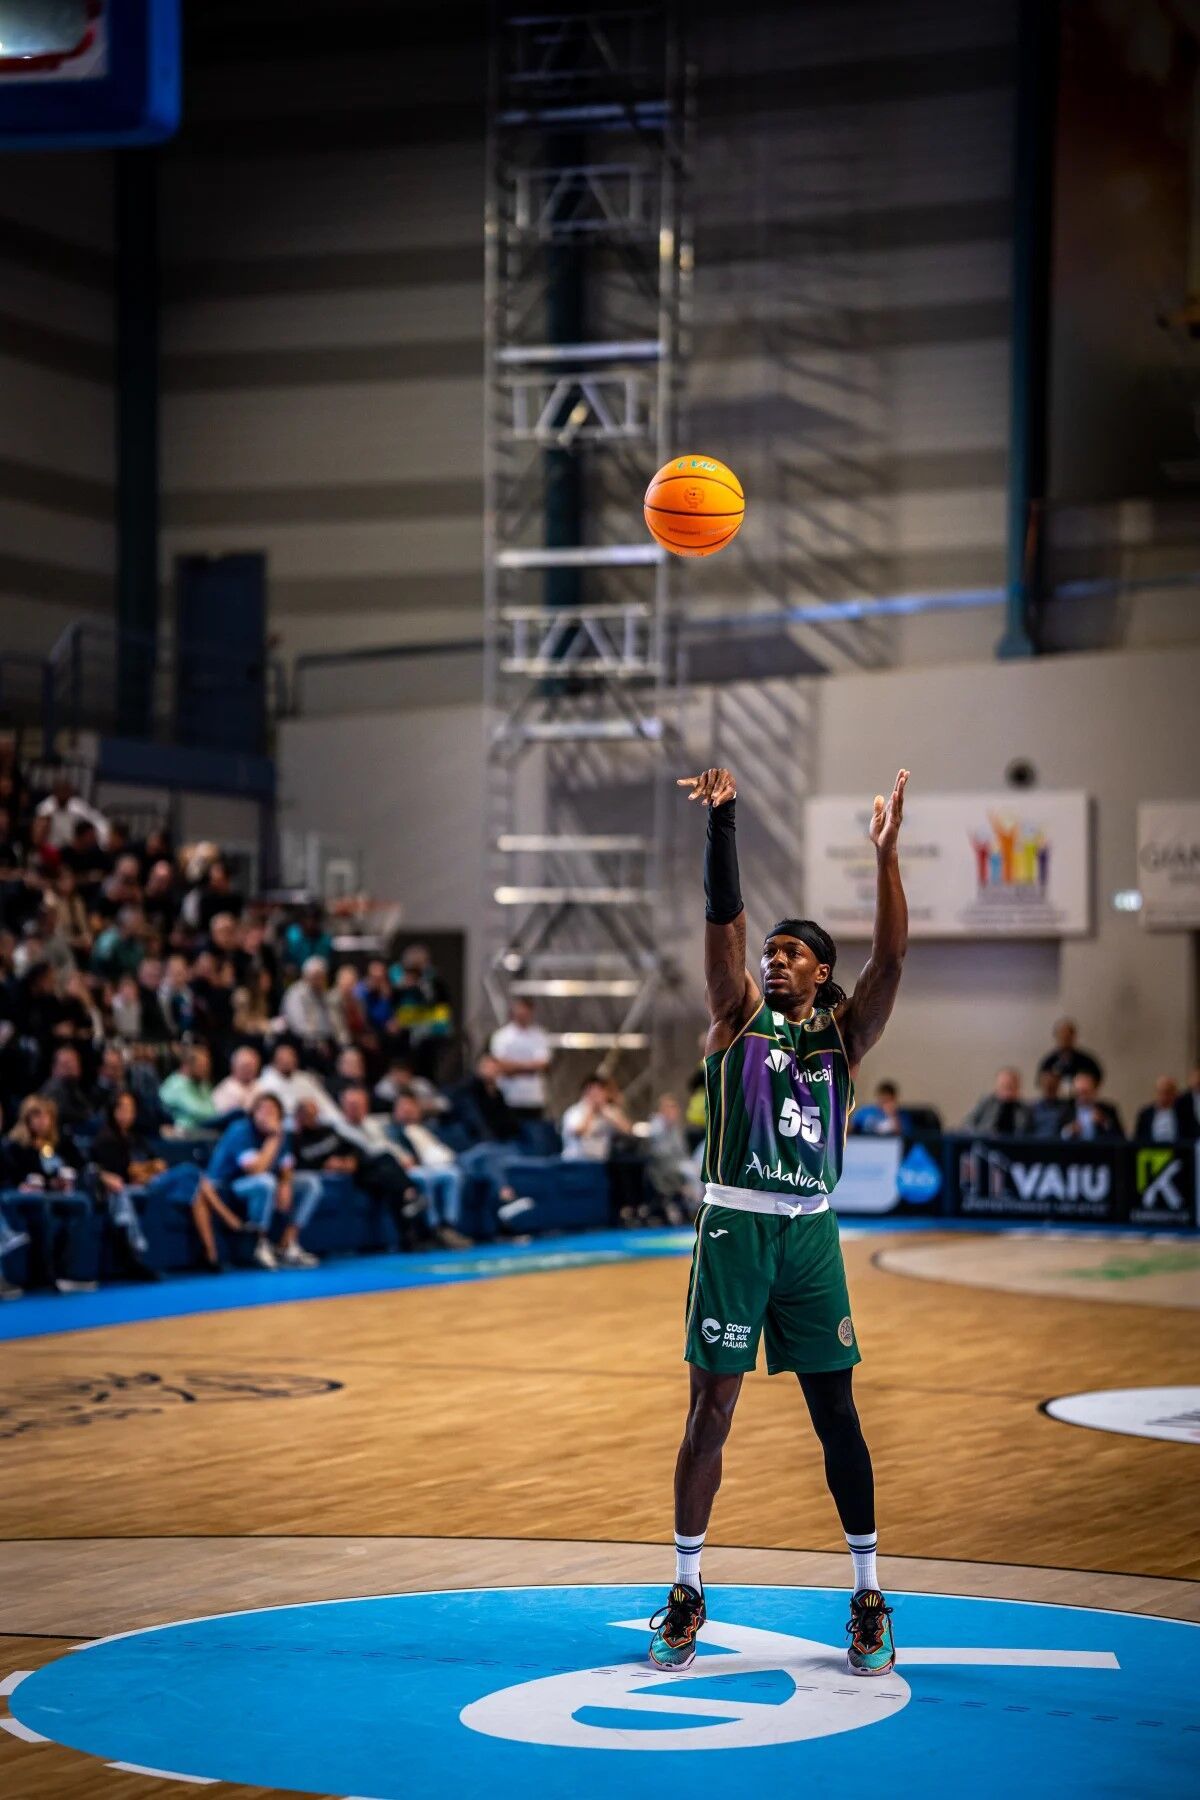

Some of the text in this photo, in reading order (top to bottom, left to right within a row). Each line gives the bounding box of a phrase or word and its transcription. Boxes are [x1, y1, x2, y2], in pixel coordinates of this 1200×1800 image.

[791, 1064, 833, 1086] Unicaj
[778, 1097, 822, 1143] 55
[1010, 1162, 1110, 1201] VAIU
[723, 1332, 736, 1341] DEL
[726, 1323, 751, 1334] COSTA
